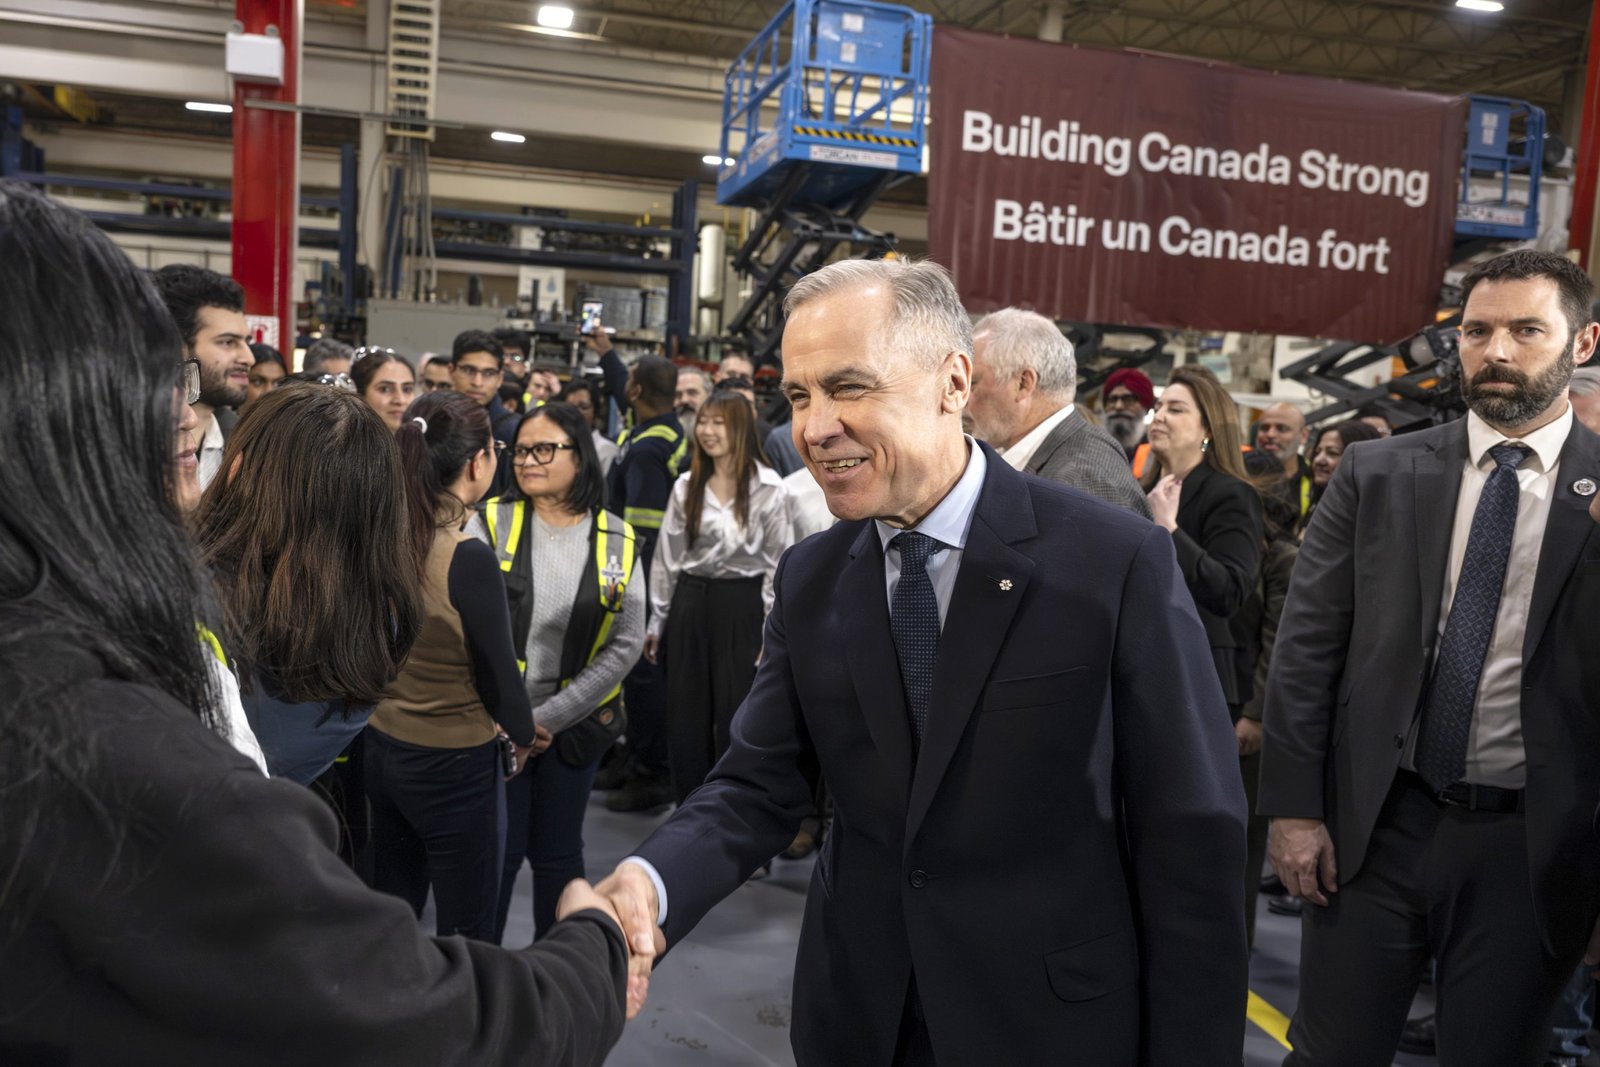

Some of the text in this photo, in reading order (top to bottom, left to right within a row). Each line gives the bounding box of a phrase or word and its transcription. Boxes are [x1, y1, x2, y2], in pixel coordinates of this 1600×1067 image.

[961, 109, 1429, 207] Building Canada Strong
[992, 198, 1390, 274] Bâtir un Canada fort
